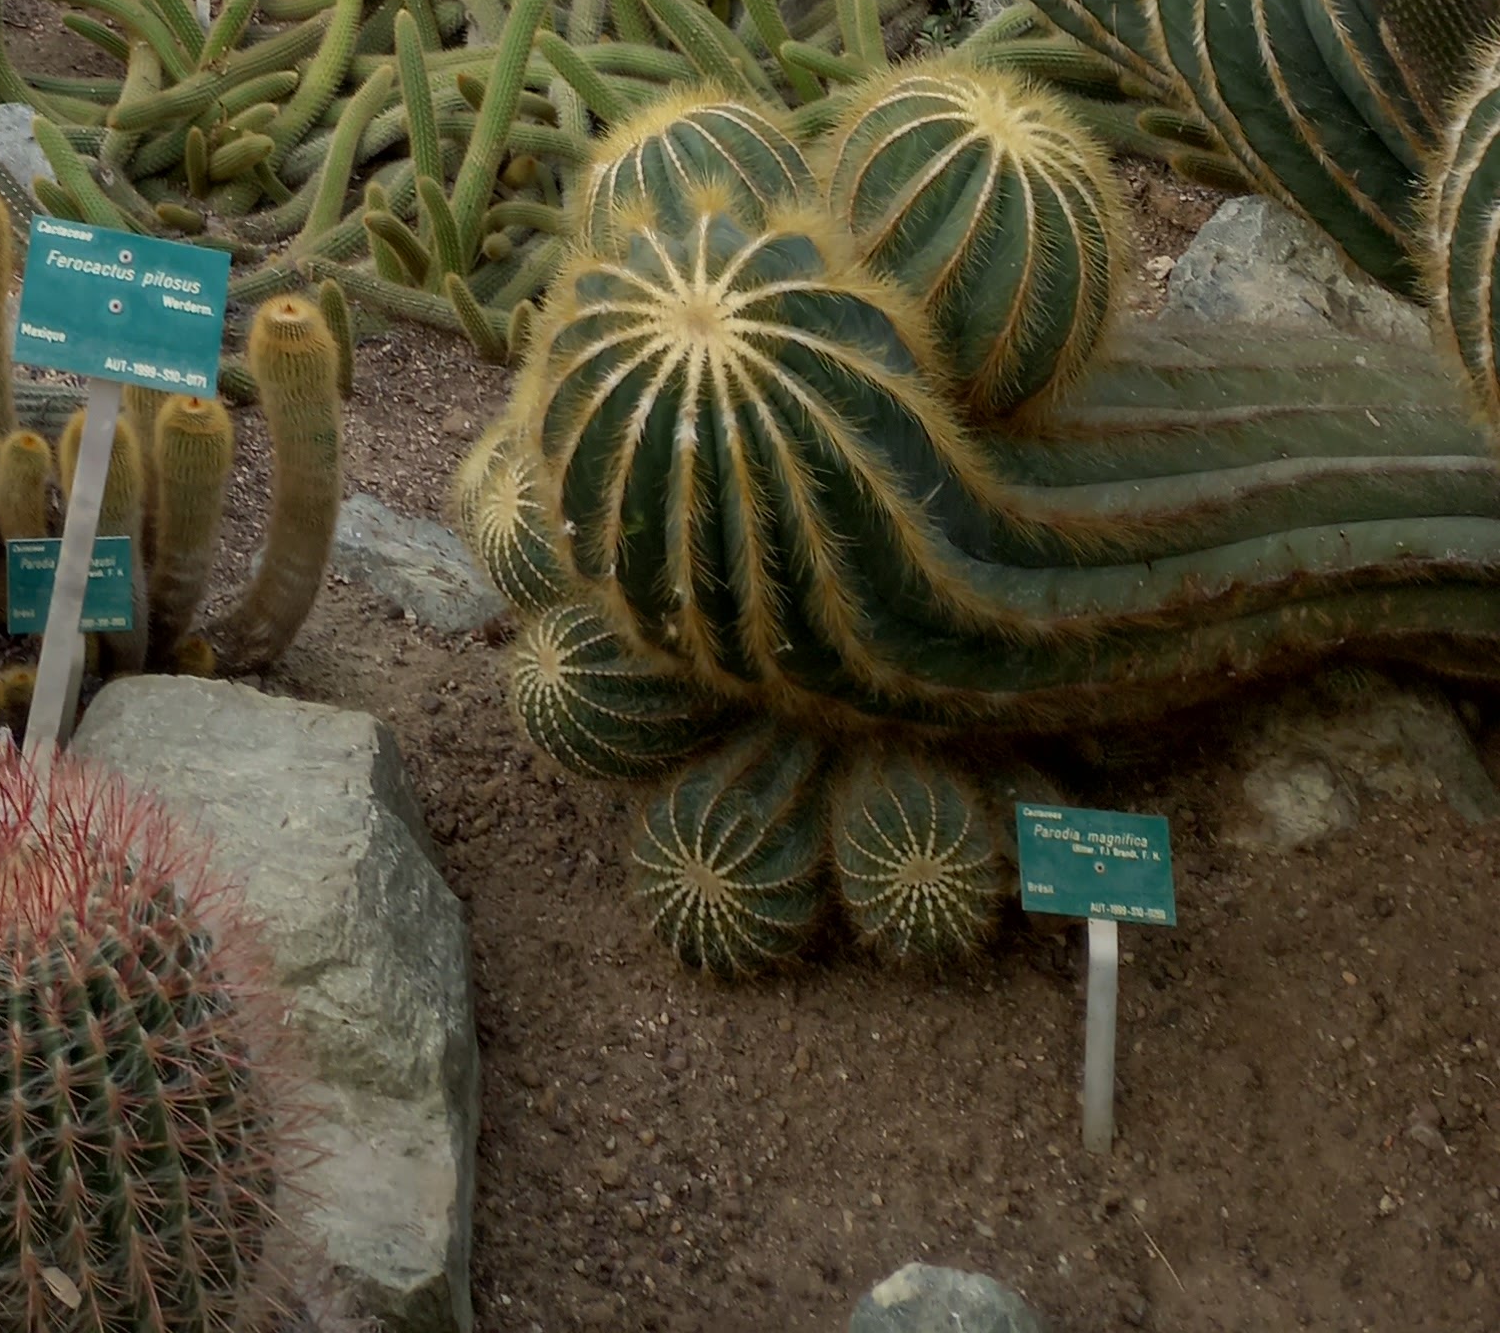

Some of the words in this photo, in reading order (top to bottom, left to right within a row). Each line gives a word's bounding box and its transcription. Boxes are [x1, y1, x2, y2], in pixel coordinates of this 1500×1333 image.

[46, 249, 136, 282] Ferocactus
[141, 270, 202, 295] pilosus
[162, 295, 215, 317] Werderm.
[1033, 824, 1081, 841] Parodia
[1087, 831, 1149, 849] magnifica
